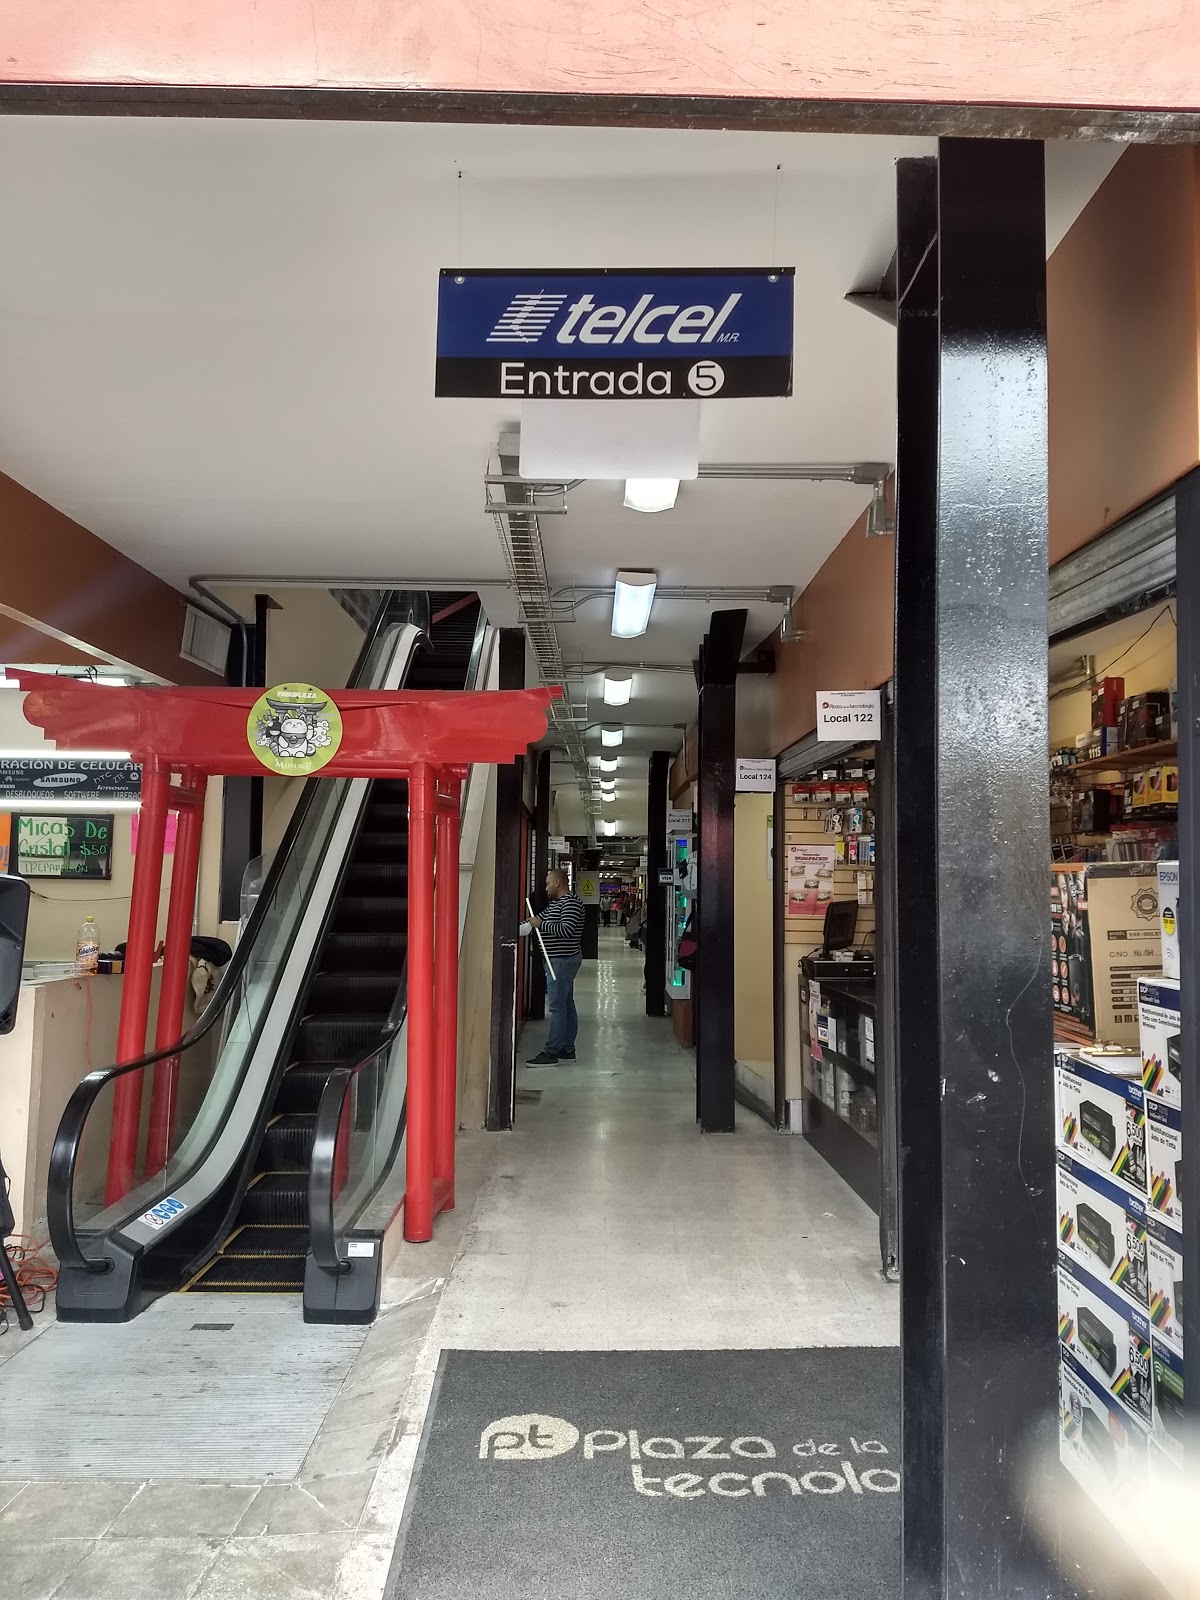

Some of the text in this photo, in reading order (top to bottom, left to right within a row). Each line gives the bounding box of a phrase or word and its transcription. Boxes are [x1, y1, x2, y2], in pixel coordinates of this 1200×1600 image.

[556, 293, 742, 343] telcel
[500, 362, 717, 395] Entrada 5
[823, 713, 873, 723] Local 122
[0, 759, 54, 770] RACIÓN
[58, 761, 76, 770] DE
[112, 772, 126, 784] ZTE
[5, 790, 55, 800] DESBLOQUEOS
[64, 790, 100, 800] SOFTWERE
[18, 818, 107, 839] Micas De
[1159, 872, 1179, 882] EPSON
[1150, 1124, 1178, 1143] Multifuncional
[792, 1438, 840, 1457] de
[850, 1437, 888, 1455] la
[631, 1461, 900, 1499] tecnolo
